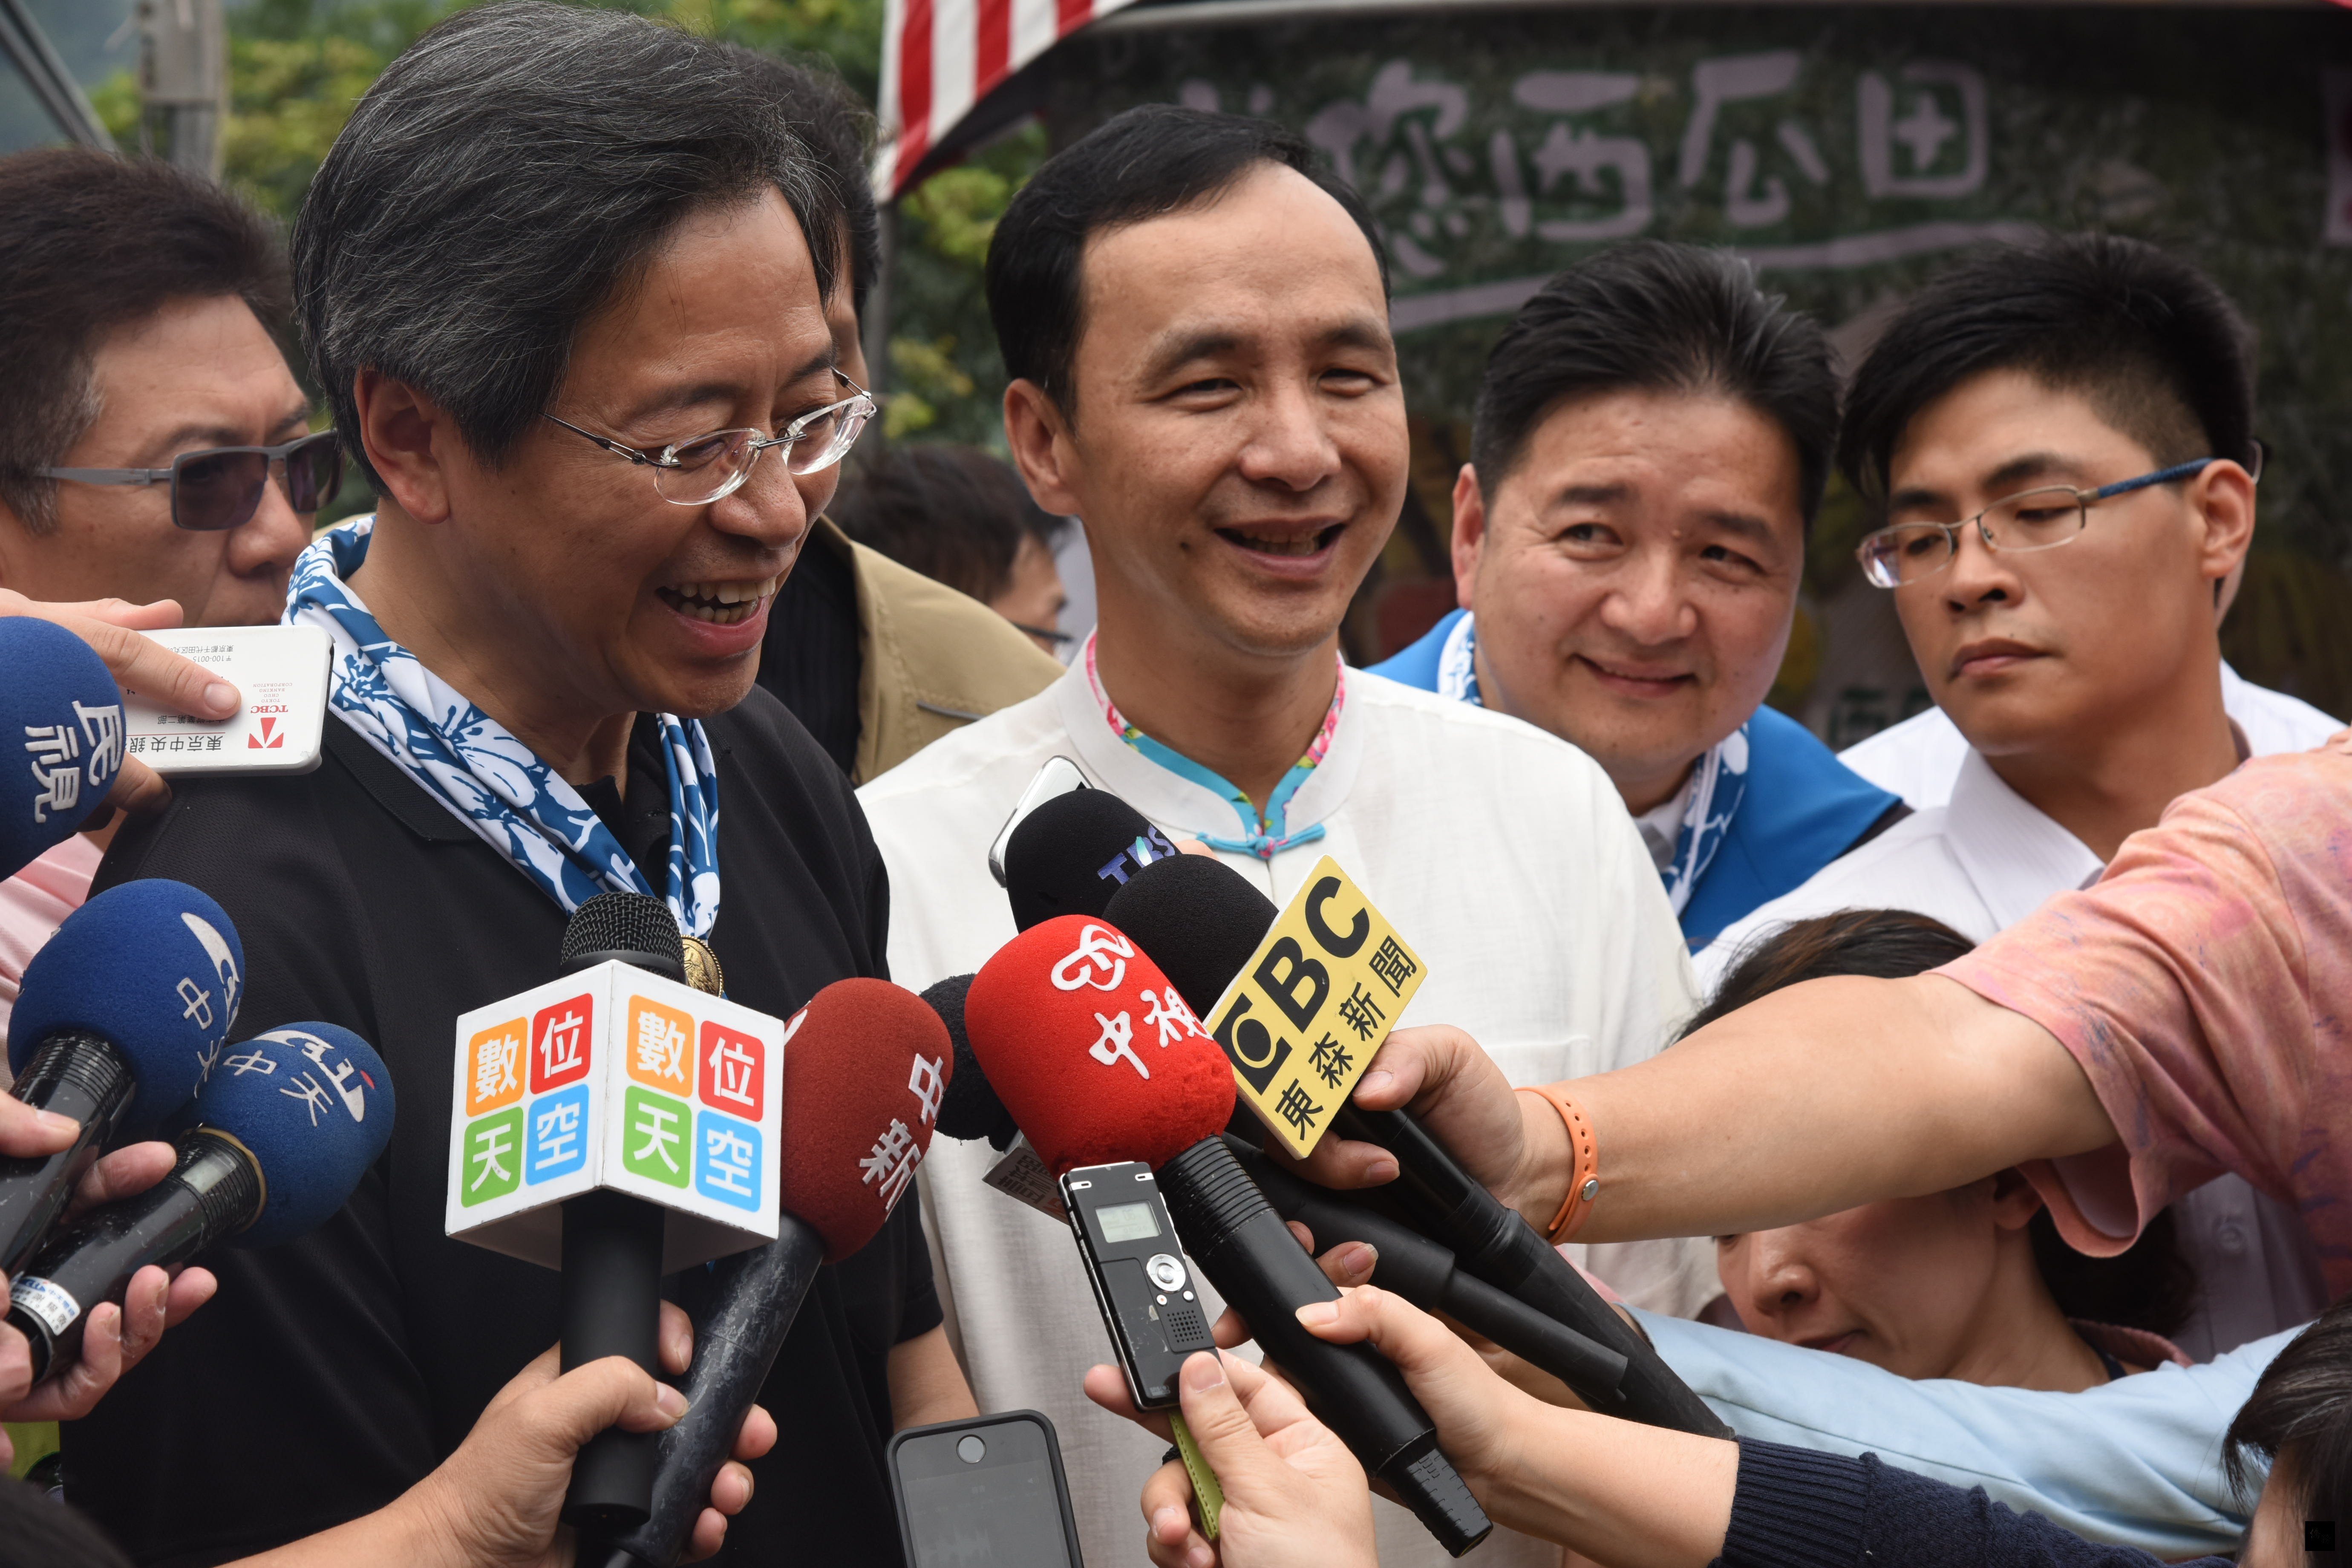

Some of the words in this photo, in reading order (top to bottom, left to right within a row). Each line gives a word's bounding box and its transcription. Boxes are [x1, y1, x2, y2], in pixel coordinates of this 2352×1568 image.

[125, 735, 223, 753] 東京中央銀
[250, 705, 288, 714] TCBC
[24, 700, 122, 823] 民視
[475, 1010, 584, 1104] 數位
[637, 1011, 755, 1107] 數位
[1274, 934, 1417, 1141] 東森新聞
[223, 1049, 334, 1127] 中天
[470, 1102, 580, 1193] 天空
[633, 1102, 753, 1198] 天空
